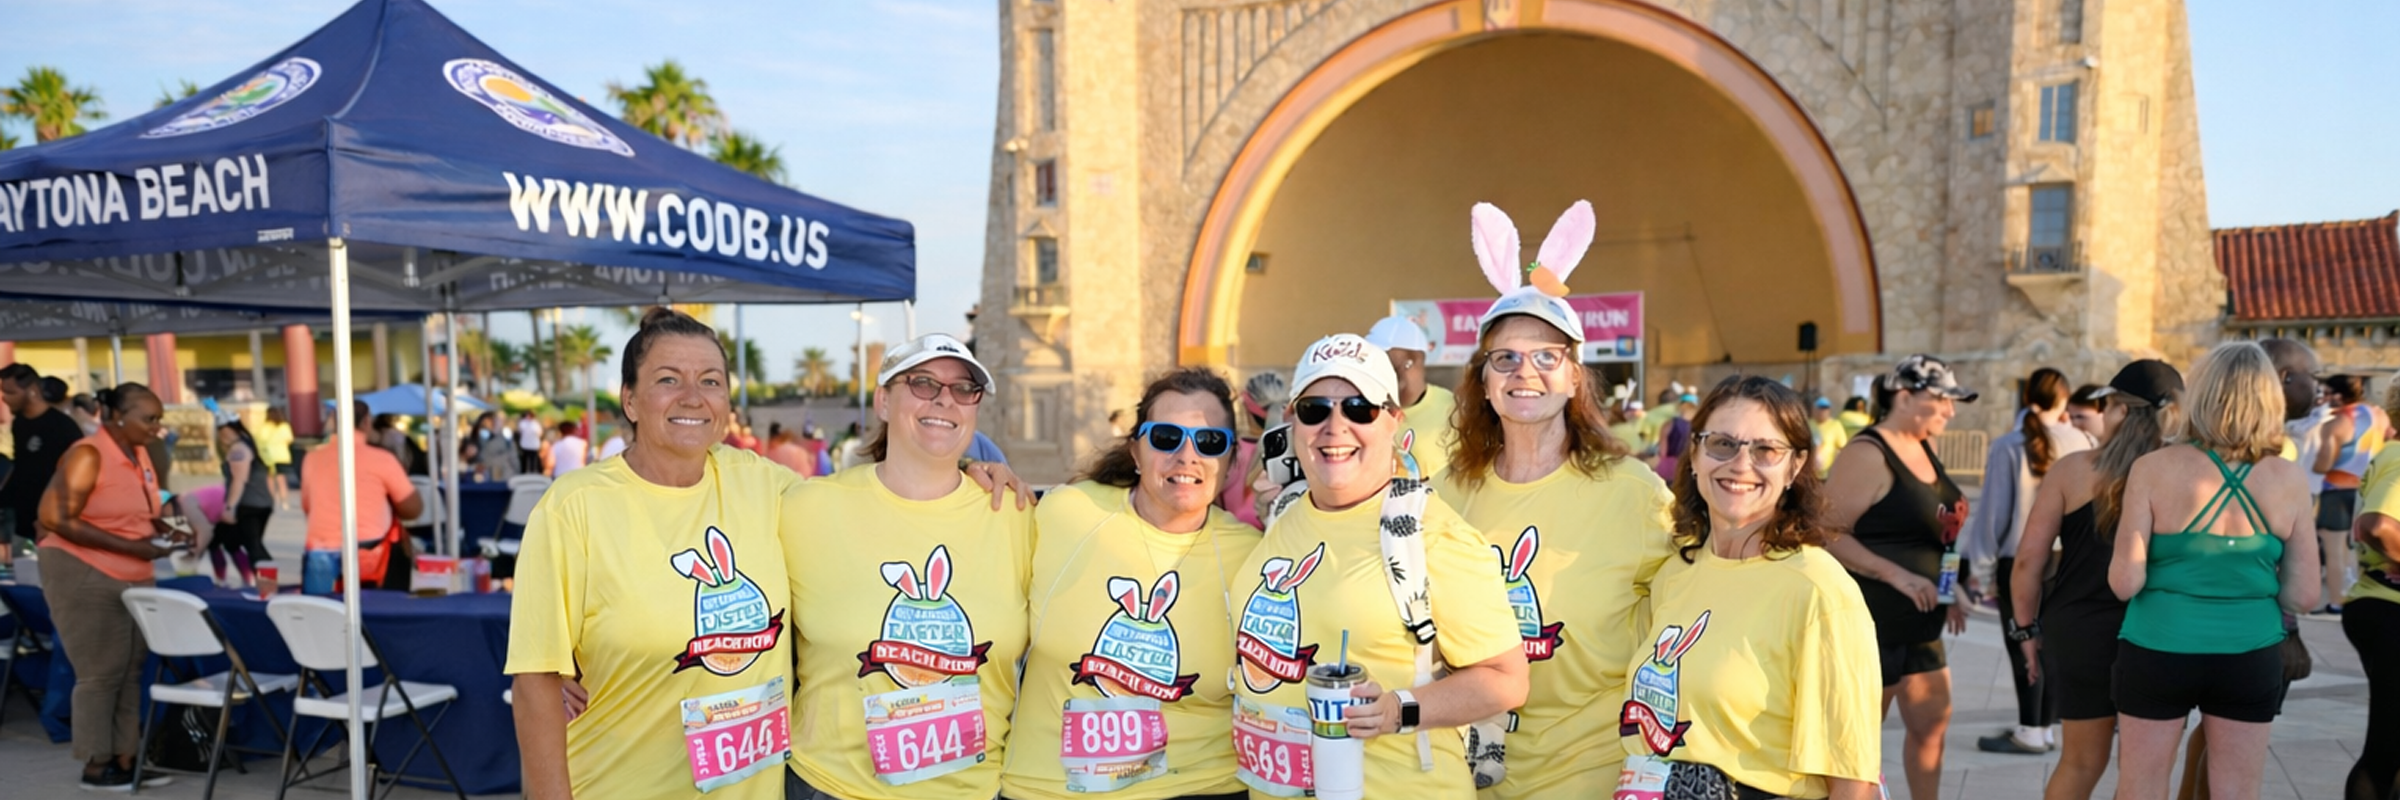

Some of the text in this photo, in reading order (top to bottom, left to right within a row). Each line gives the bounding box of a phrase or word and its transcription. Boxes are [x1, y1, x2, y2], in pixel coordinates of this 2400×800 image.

[0, 153, 270, 232] AYTONA BEACH
[502, 171, 830, 270] WWW.CODB.US
[888, 622, 966, 640] EASTER
[896, 718, 967, 771] 644
